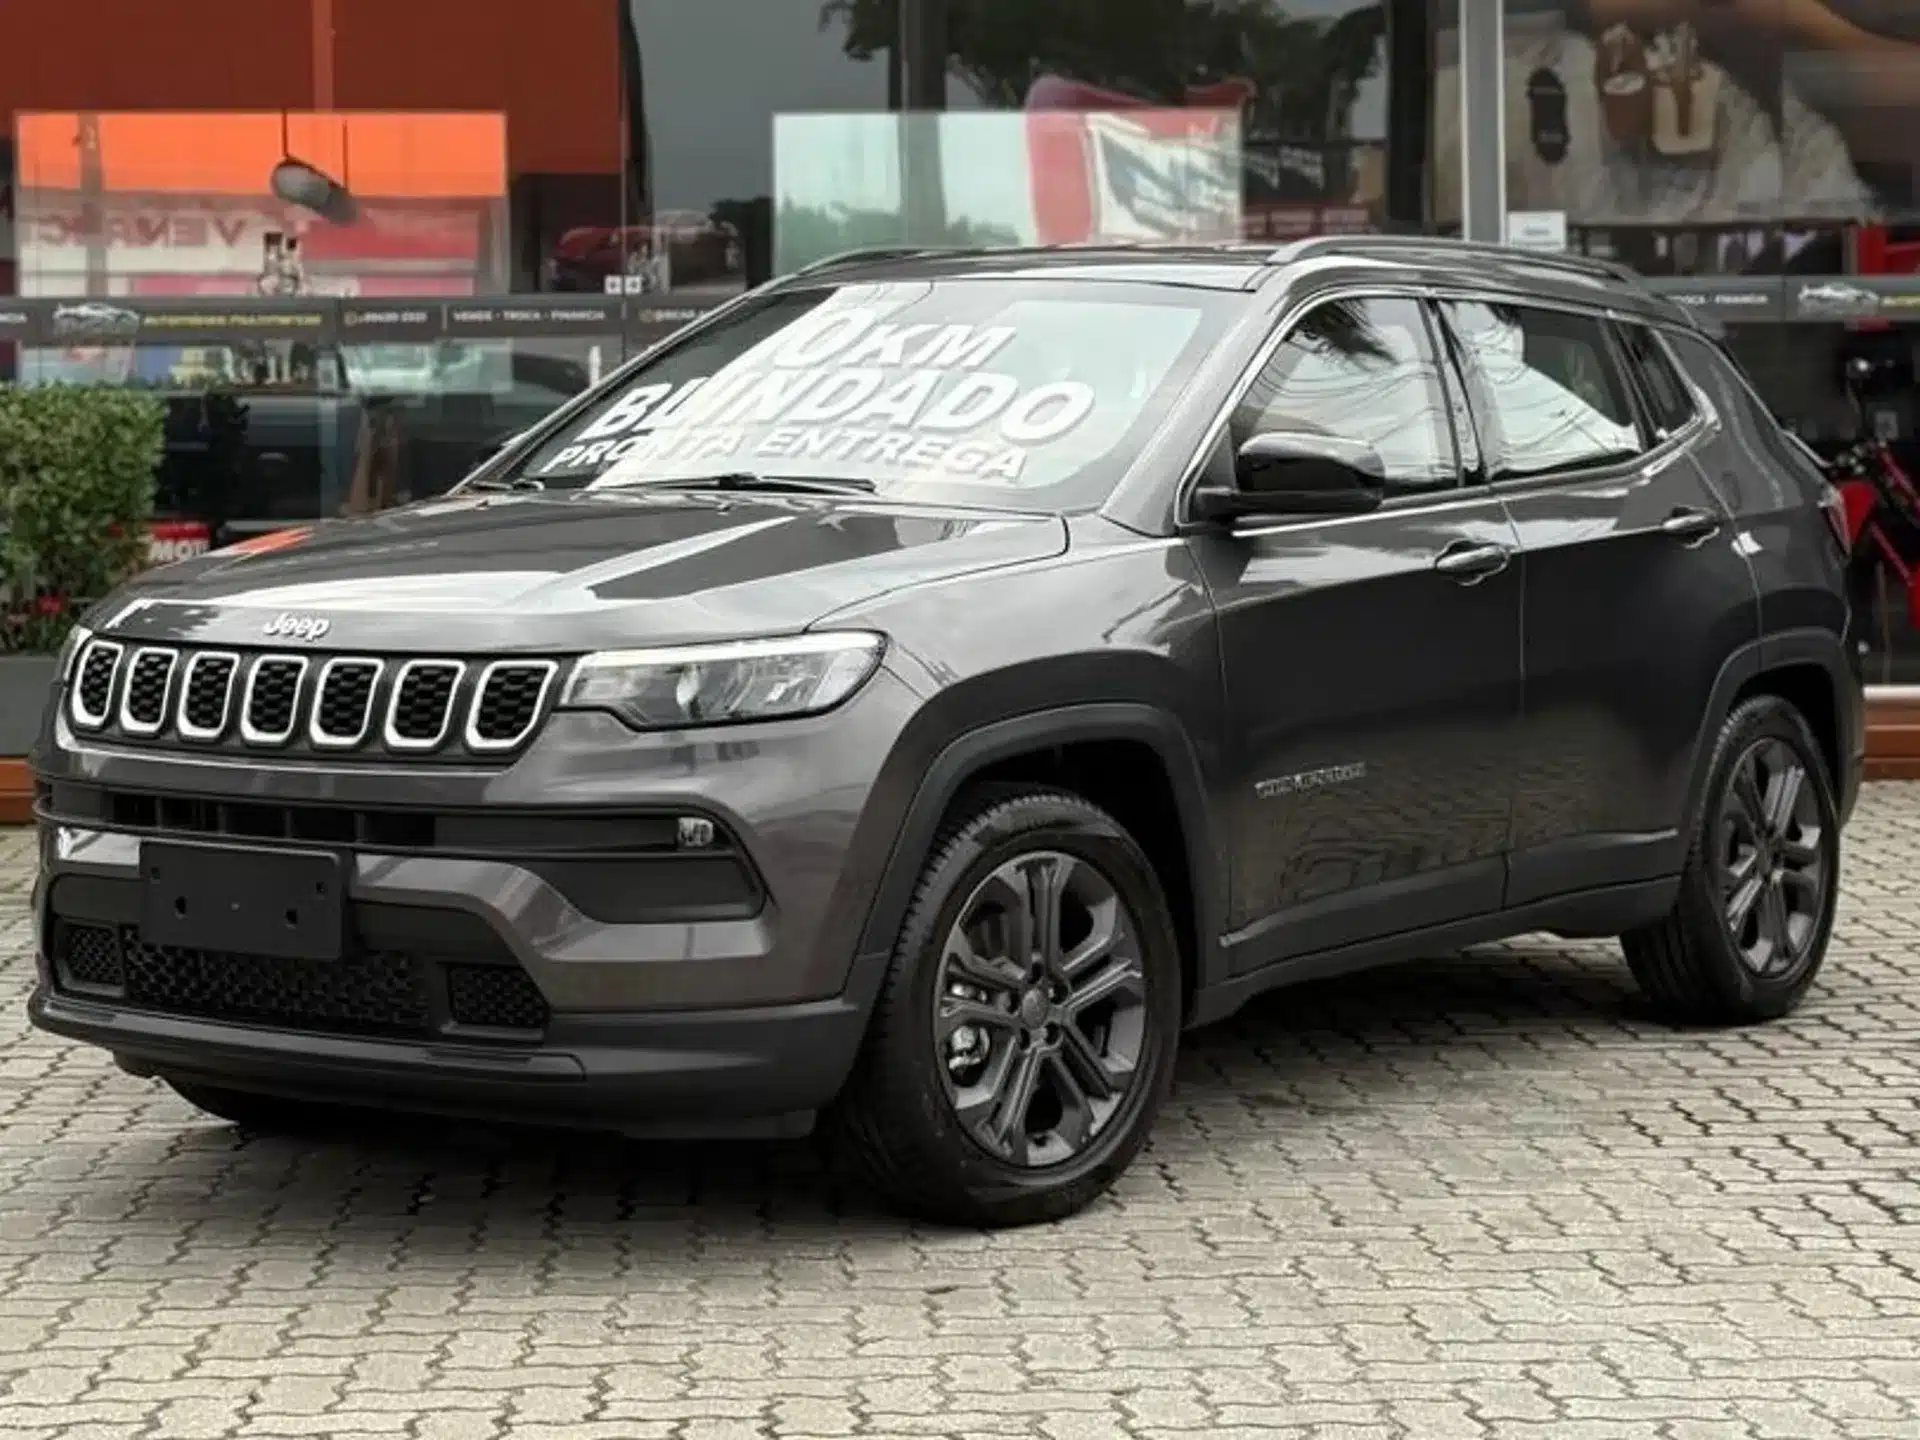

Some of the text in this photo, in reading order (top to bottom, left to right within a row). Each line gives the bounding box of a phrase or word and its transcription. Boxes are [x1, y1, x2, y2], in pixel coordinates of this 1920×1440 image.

[573, 368, 1094, 447] BLINDADO
[753, 424, 1027, 482] ENTREGA
[264, 612, 331, 641] Jeep
